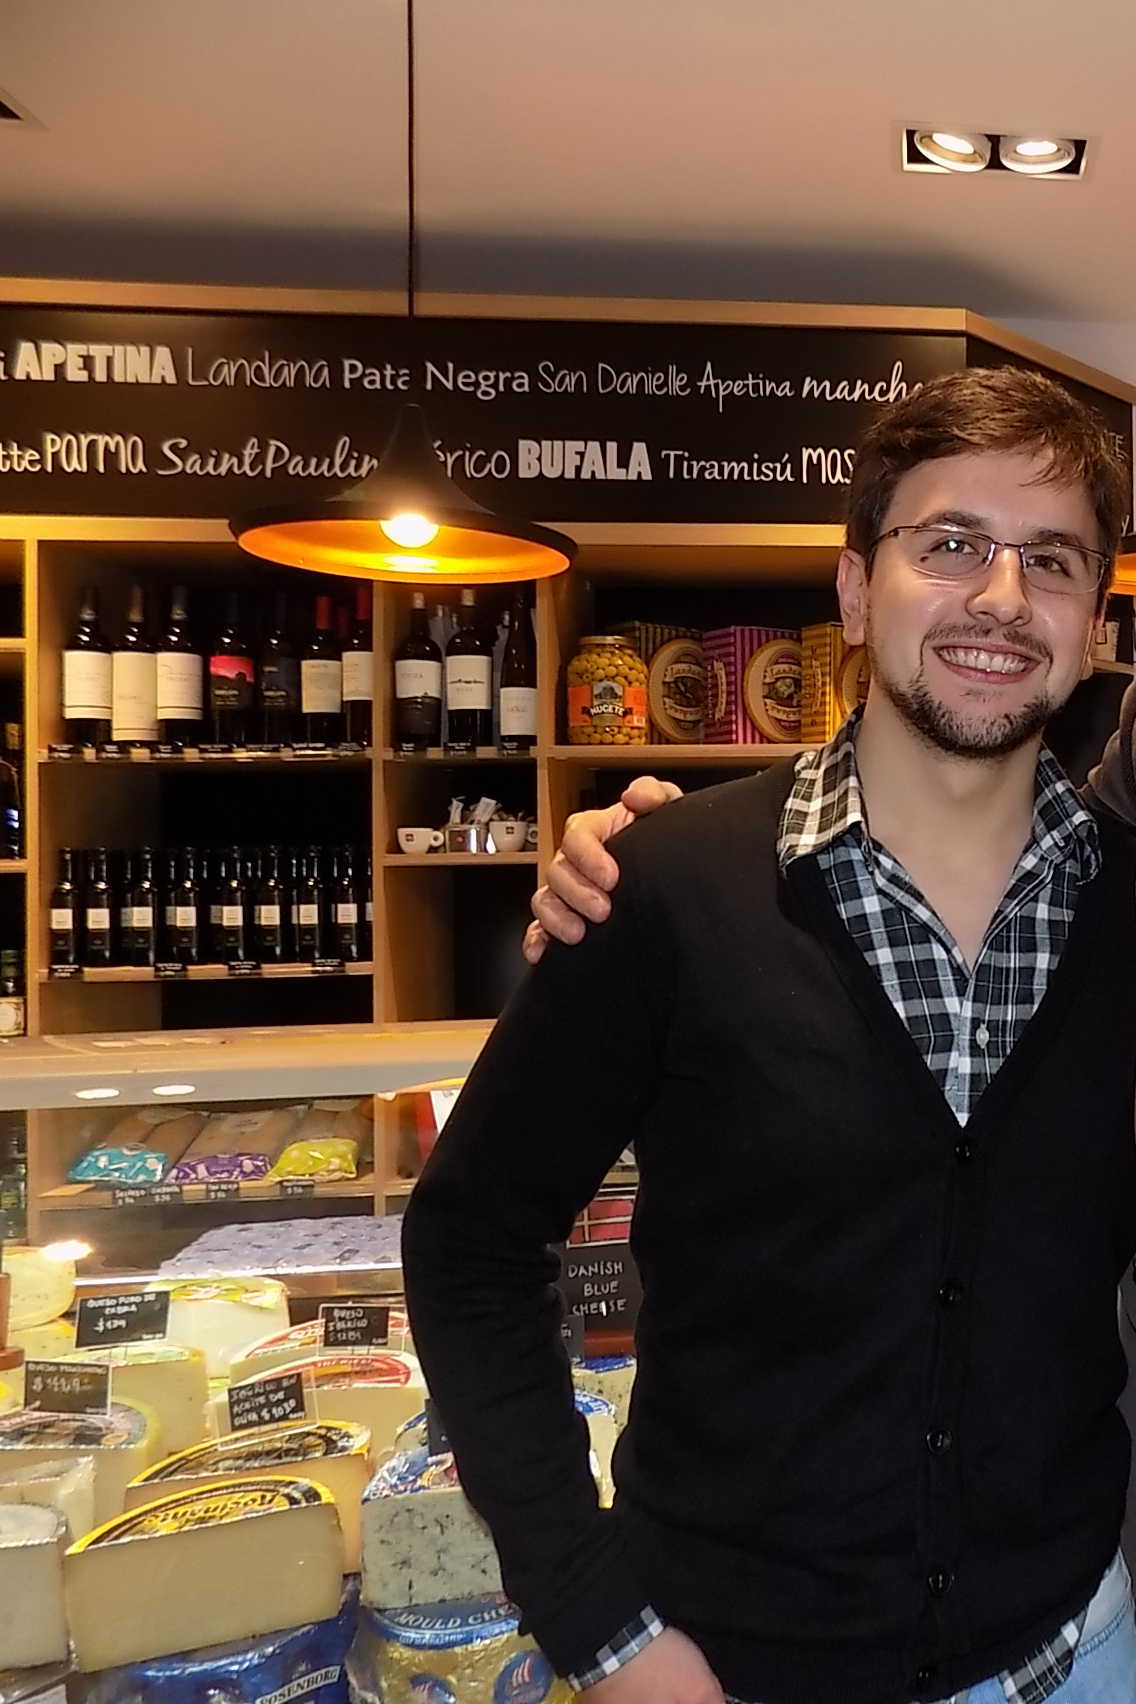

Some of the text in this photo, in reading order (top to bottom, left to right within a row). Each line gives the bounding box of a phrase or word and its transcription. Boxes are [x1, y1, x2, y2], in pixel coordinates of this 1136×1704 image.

[15, 341, 177, 384] APETINA
[187, 347, 331, 388] Landana
[425, 361, 530, 401] Negra
[538, 361, 587, 393] San
[598, 362, 691, 396] Danielle
[697, 361, 795, 413] Apetina
[518, 439, 652, 480] BUFALA
[661, 450, 795, 483] Tiramisú
[590, 704, 626, 717] NUCETE
[584, 1280, 619, 1297] BLUE
[394, 1612, 461, 1629] MOULD
